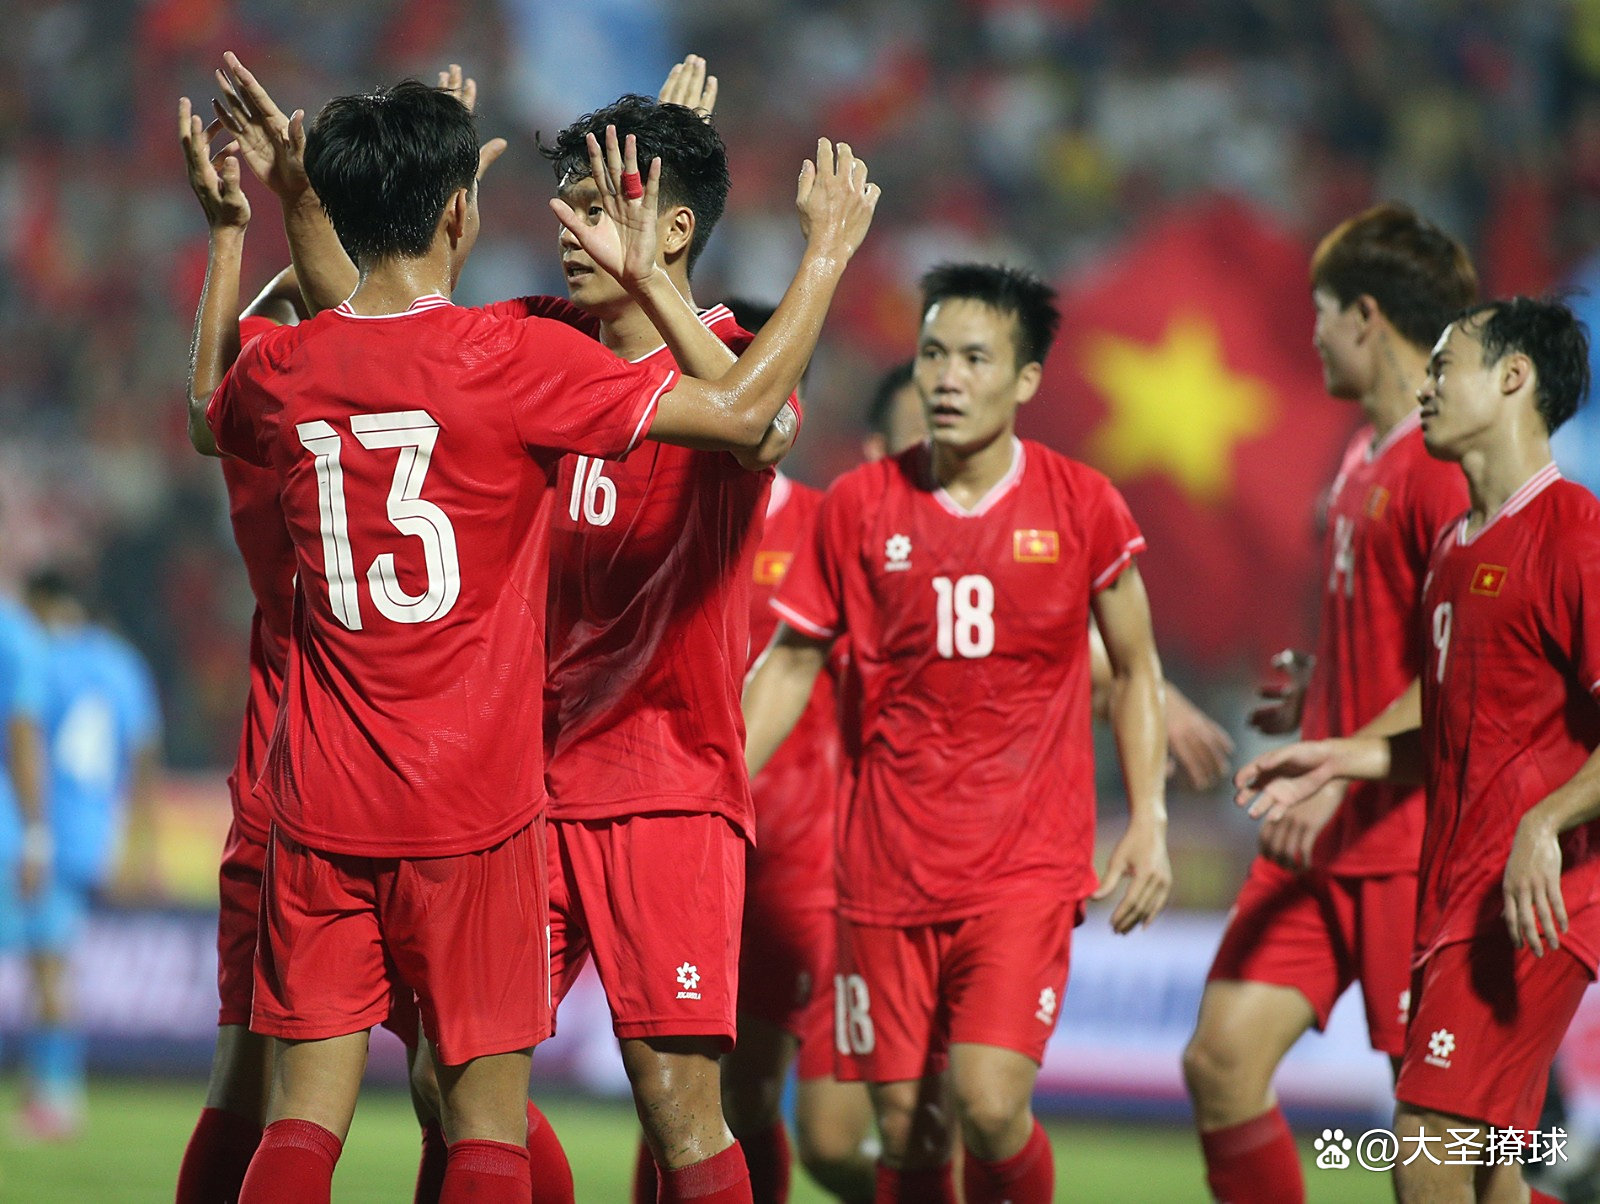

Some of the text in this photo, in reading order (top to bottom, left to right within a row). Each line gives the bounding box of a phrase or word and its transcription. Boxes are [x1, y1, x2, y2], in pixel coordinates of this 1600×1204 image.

[295, 409, 461, 631] 13
[569, 454, 617, 526] 16
[932, 574, 995, 659] 18
[1433, 601, 1452, 685] 9
[834, 973, 875, 1056] 18
